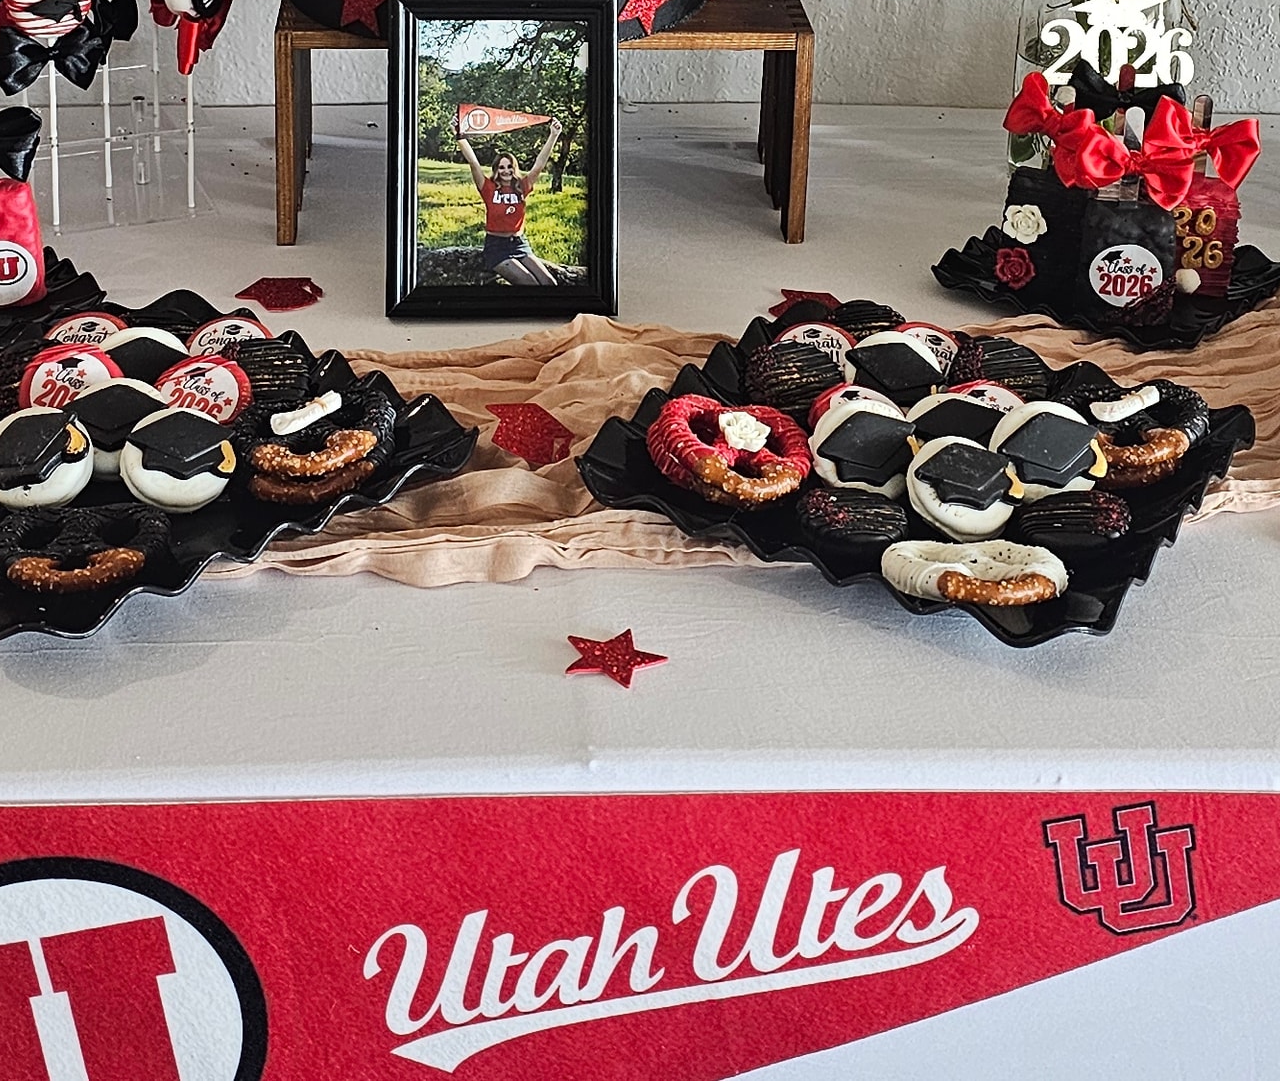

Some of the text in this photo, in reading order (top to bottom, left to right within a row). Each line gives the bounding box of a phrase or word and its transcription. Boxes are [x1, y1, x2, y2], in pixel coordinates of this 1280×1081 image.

[1040, 18, 1196, 88] 2026
[1098, 272, 1154, 297] 2026
[363, 848, 970, 1035] Utah Utes
